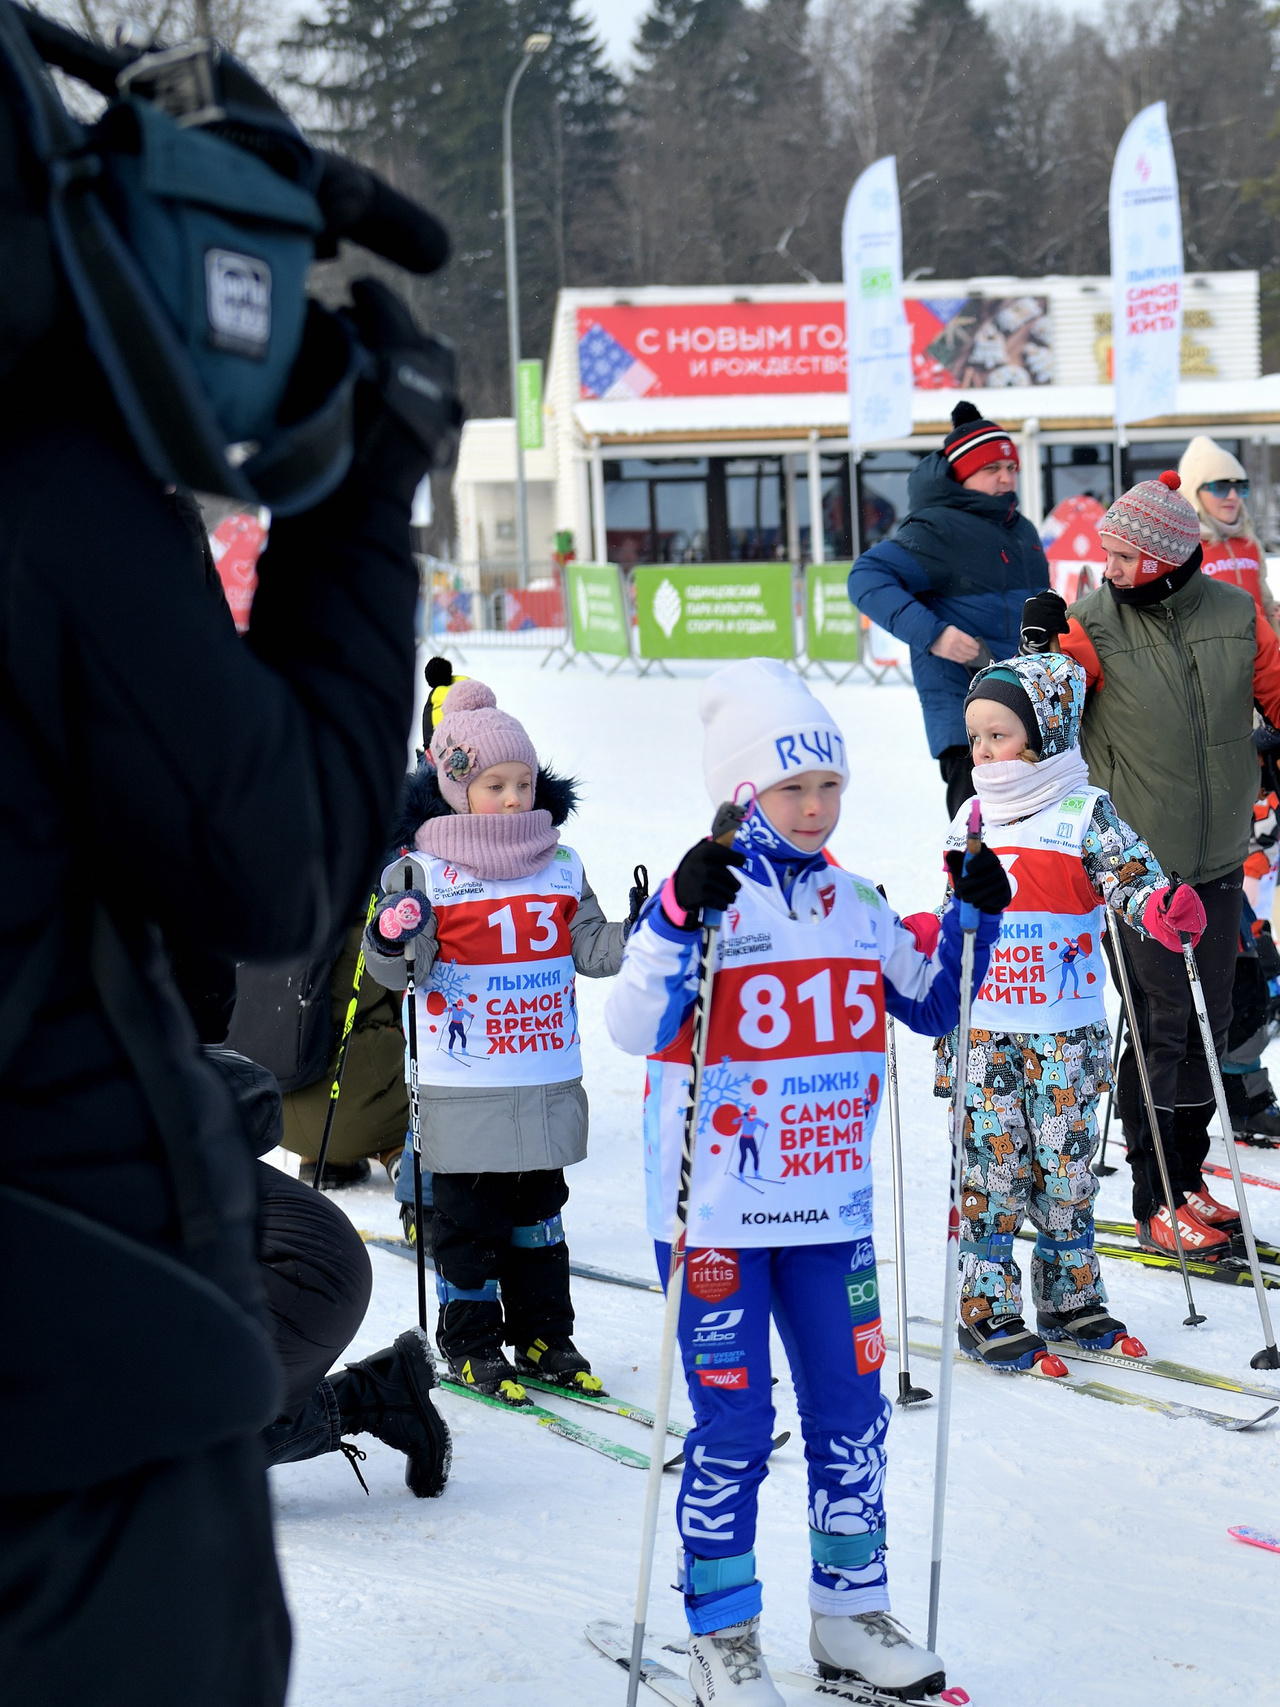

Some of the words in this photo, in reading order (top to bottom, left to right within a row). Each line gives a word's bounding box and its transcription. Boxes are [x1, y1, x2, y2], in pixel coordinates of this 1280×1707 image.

[636, 327, 660, 353] С
[667, 324, 791, 353] НОВЫМ
[690, 360, 706, 377] И
[712, 355, 849, 377] РОЖДЕСТВО
[488, 901, 558, 955] 13
[487, 969, 561, 992] ЛЫЖНЯ
[486, 991, 562, 1016] САМОЕ
[737, 967, 878, 1050] 815
[486, 1011, 564, 1036] ВРЕМЯ
[486, 1032, 564, 1055] ЖИТЬ
[411, 1058, 422, 1152] FISCHER
[780, 1097, 864, 1126] САМОЕ
[780, 1121, 864, 1151] ВРЕМЯ
[780, 1147, 864, 1178] ЖИТЬ
[742, 1208, 830, 1226] КОМАНДА
[692, 1266, 734, 1282] rittis
[692, 1331, 736, 1343] Julbo
[692, 1644, 716, 1701] MADSHUS
